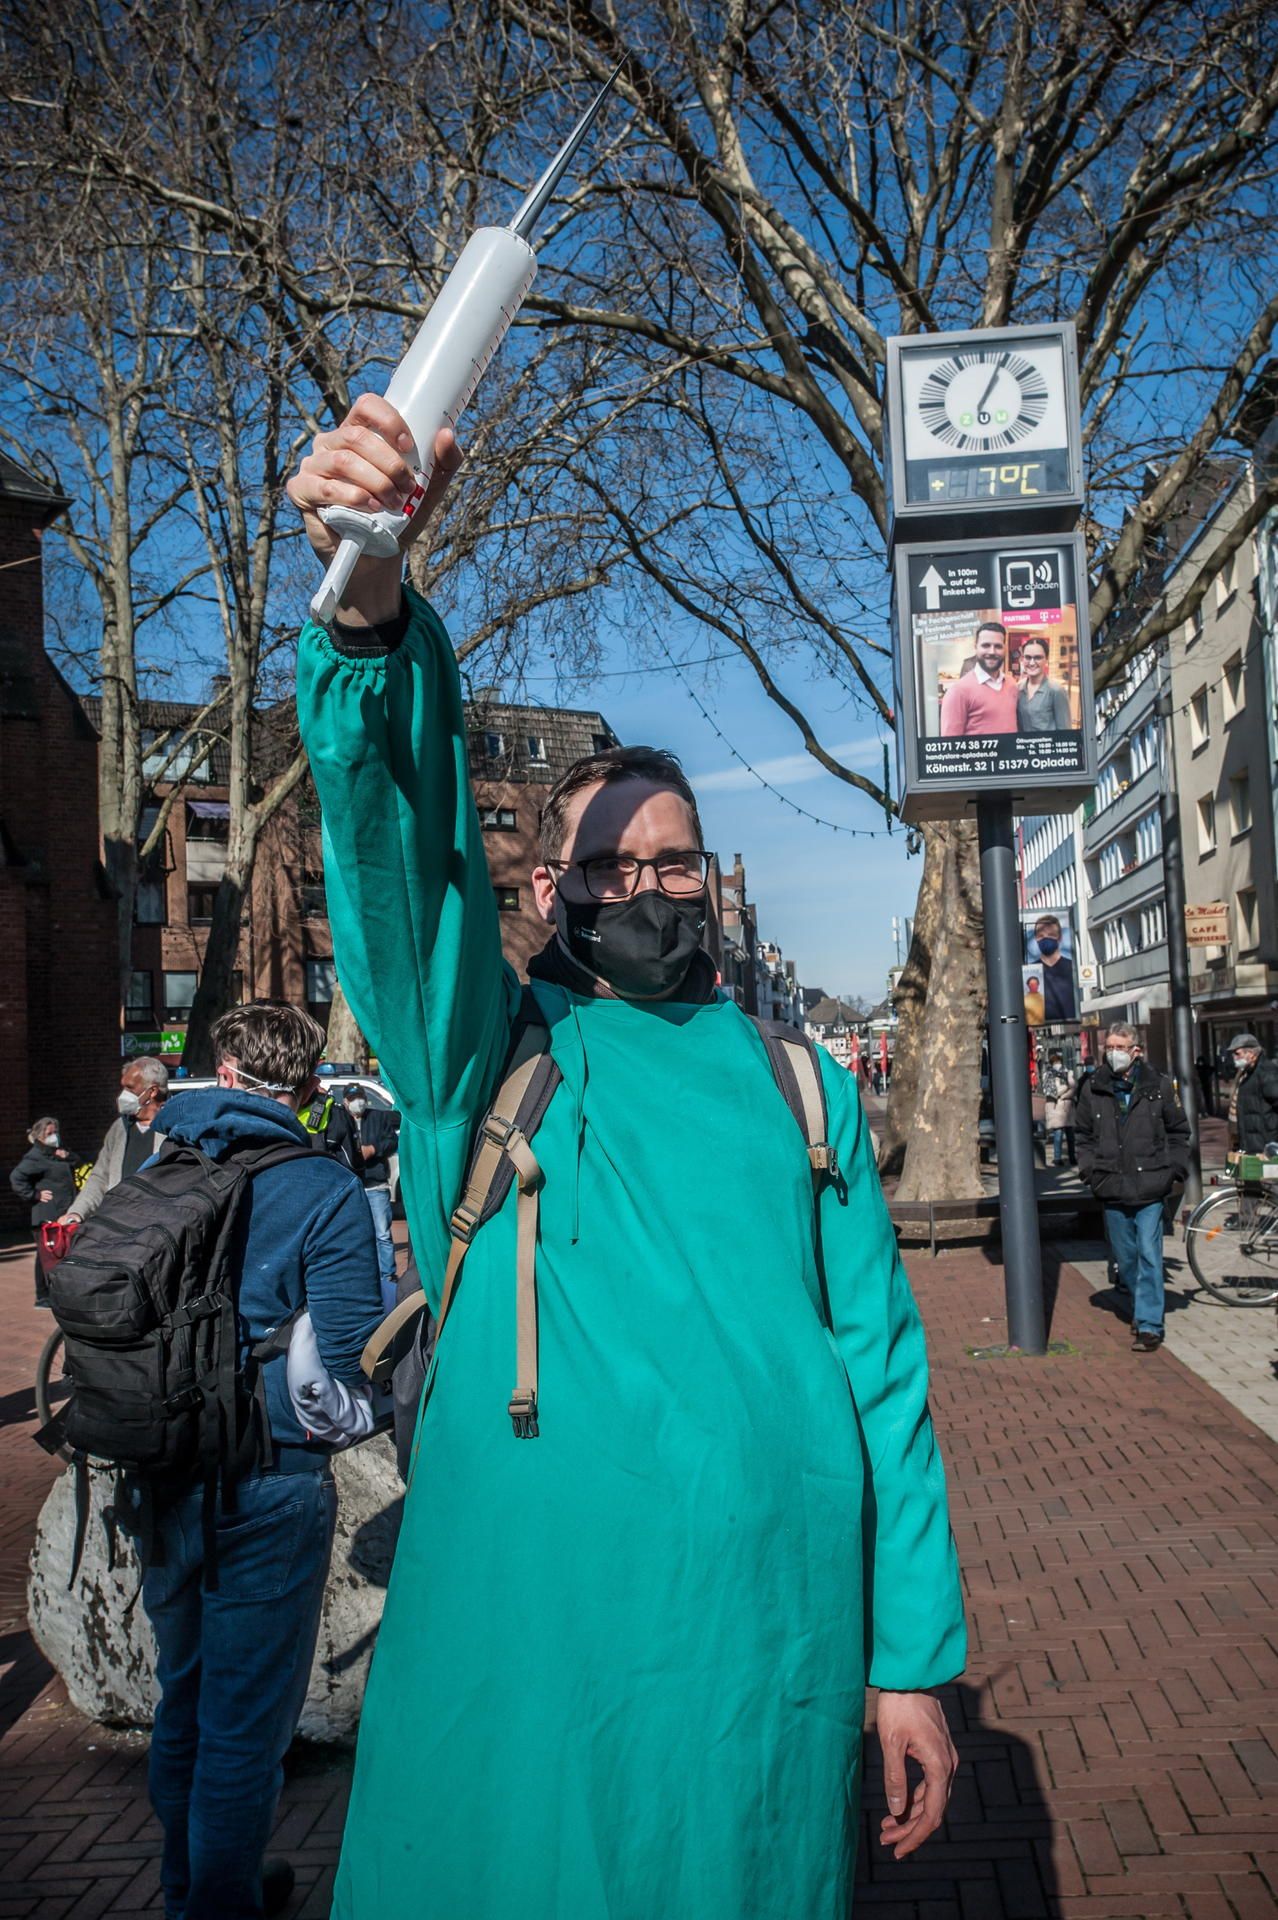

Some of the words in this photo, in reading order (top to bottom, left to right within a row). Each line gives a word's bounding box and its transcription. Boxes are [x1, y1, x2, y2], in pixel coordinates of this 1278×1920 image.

[967, 587, 985, 595] Seite
[1004, 614, 1030, 622] PARTNER
[925, 742, 952, 752] 02171
[955, 741, 966, 750] 74
[968, 741, 980, 749] 38
[982, 740, 998, 749] 777
[926, 762, 972, 773] Kölnerstr.
[974, 762, 987, 771] 32
[999, 760, 1028, 769] 51379
[1031, 758, 1078, 769] Opladen
[1192, 925, 1217, 933] CAFÉ
